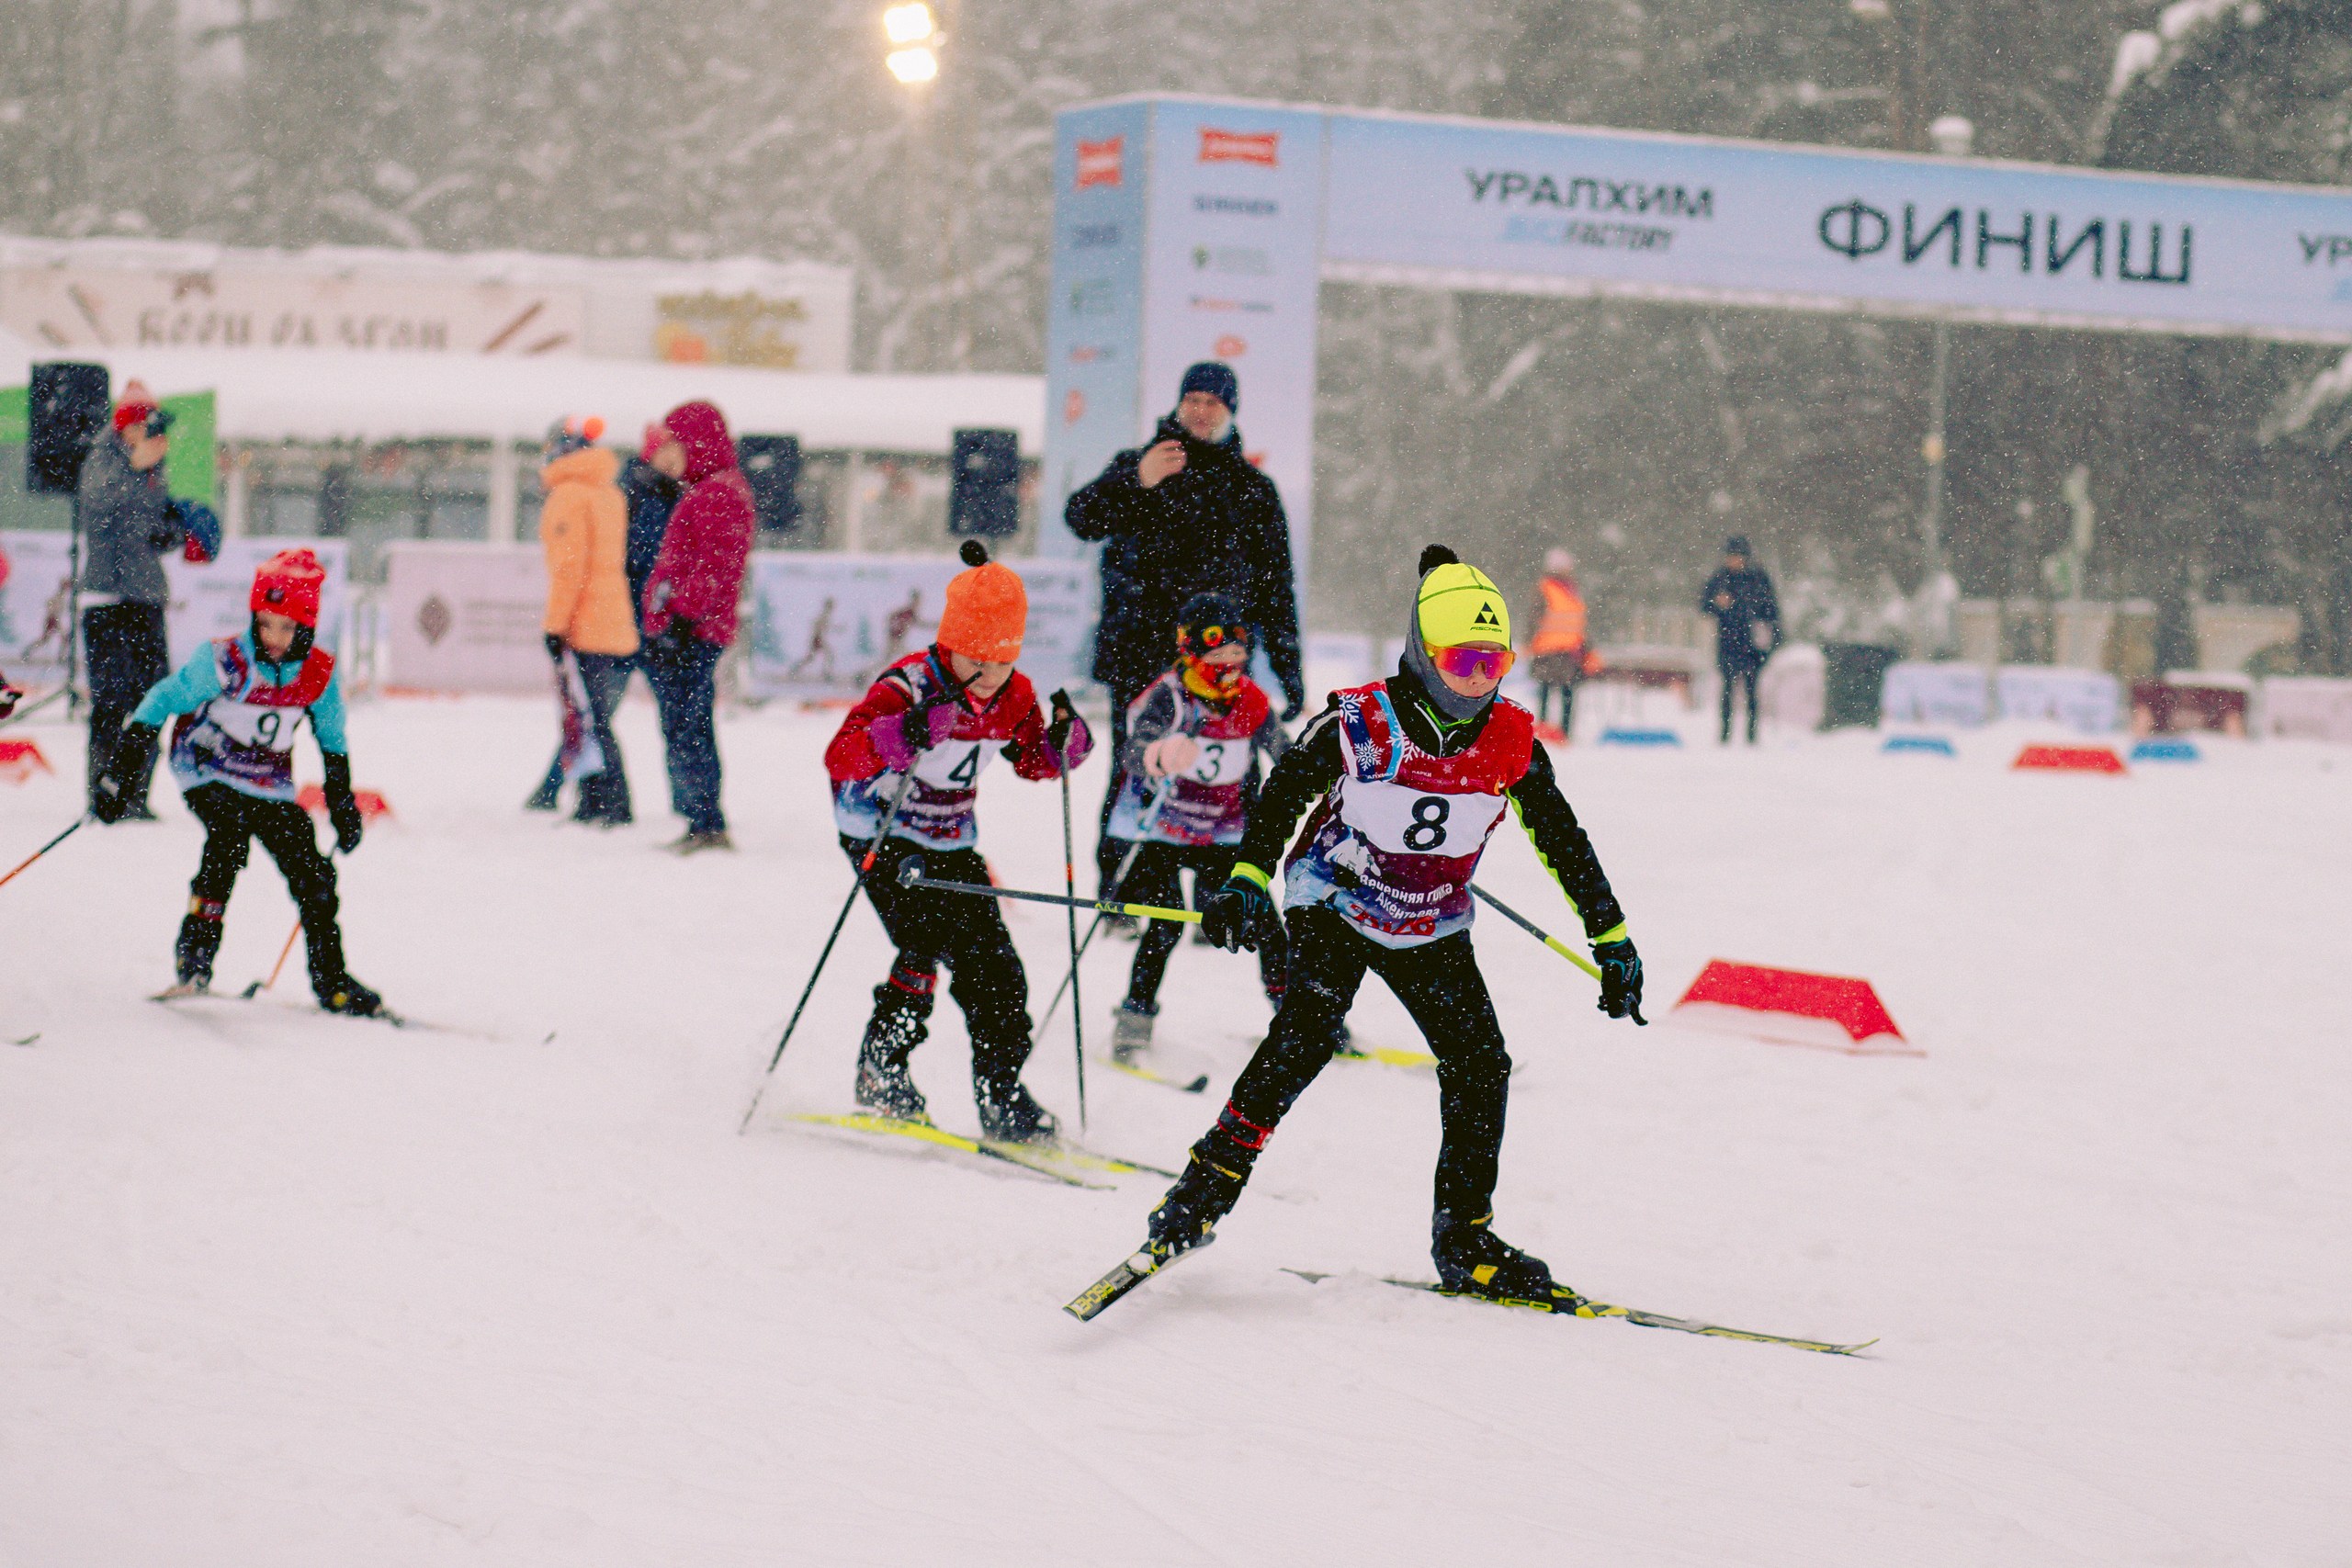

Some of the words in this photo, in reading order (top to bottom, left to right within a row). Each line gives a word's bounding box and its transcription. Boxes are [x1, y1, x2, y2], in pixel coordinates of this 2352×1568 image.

[1464, 165, 1714, 220] УРАЛХИМ
[1818, 198, 2195, 284] ФИНИШ
[252, 711, 280, 747] 9
[947, 743, 981, 788] 4
[1196, 743, 1225, 782] 3
[1402, 795, 1451, 852] 8
